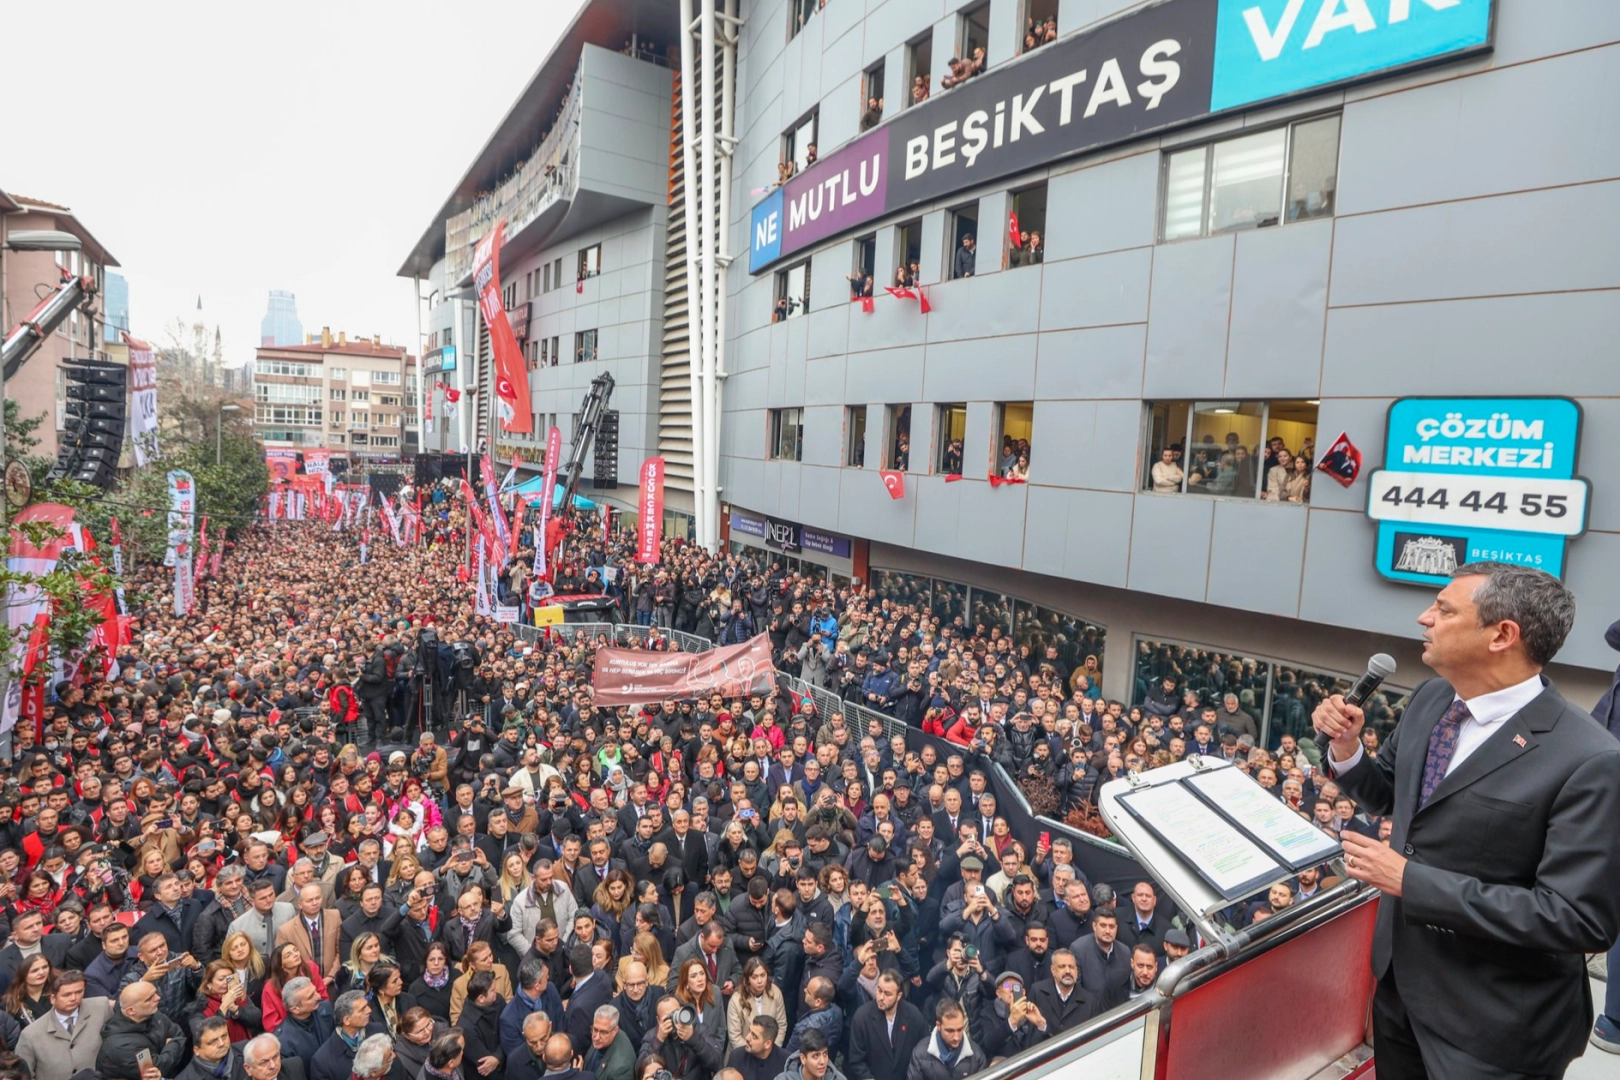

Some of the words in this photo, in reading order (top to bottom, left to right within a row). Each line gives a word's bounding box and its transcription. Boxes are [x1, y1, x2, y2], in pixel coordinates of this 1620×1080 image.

[756, 210, 778, 252] NE
[789, 153, 880, 232] MUTLU
[905, 38, 1182, 181] BEŞİKTAŞ
[1415, 412, 1545, 442] ÇÖZÜM
[1402, 441, 1555, 469] MERKEZİ
[1381, 485, 1449, 509] 444
[1459, 490, 1508, 514] 44
[1519, 493, 1569, 519] 55
[1471, 548, 1543, 565] BEŞİKTAŞ
